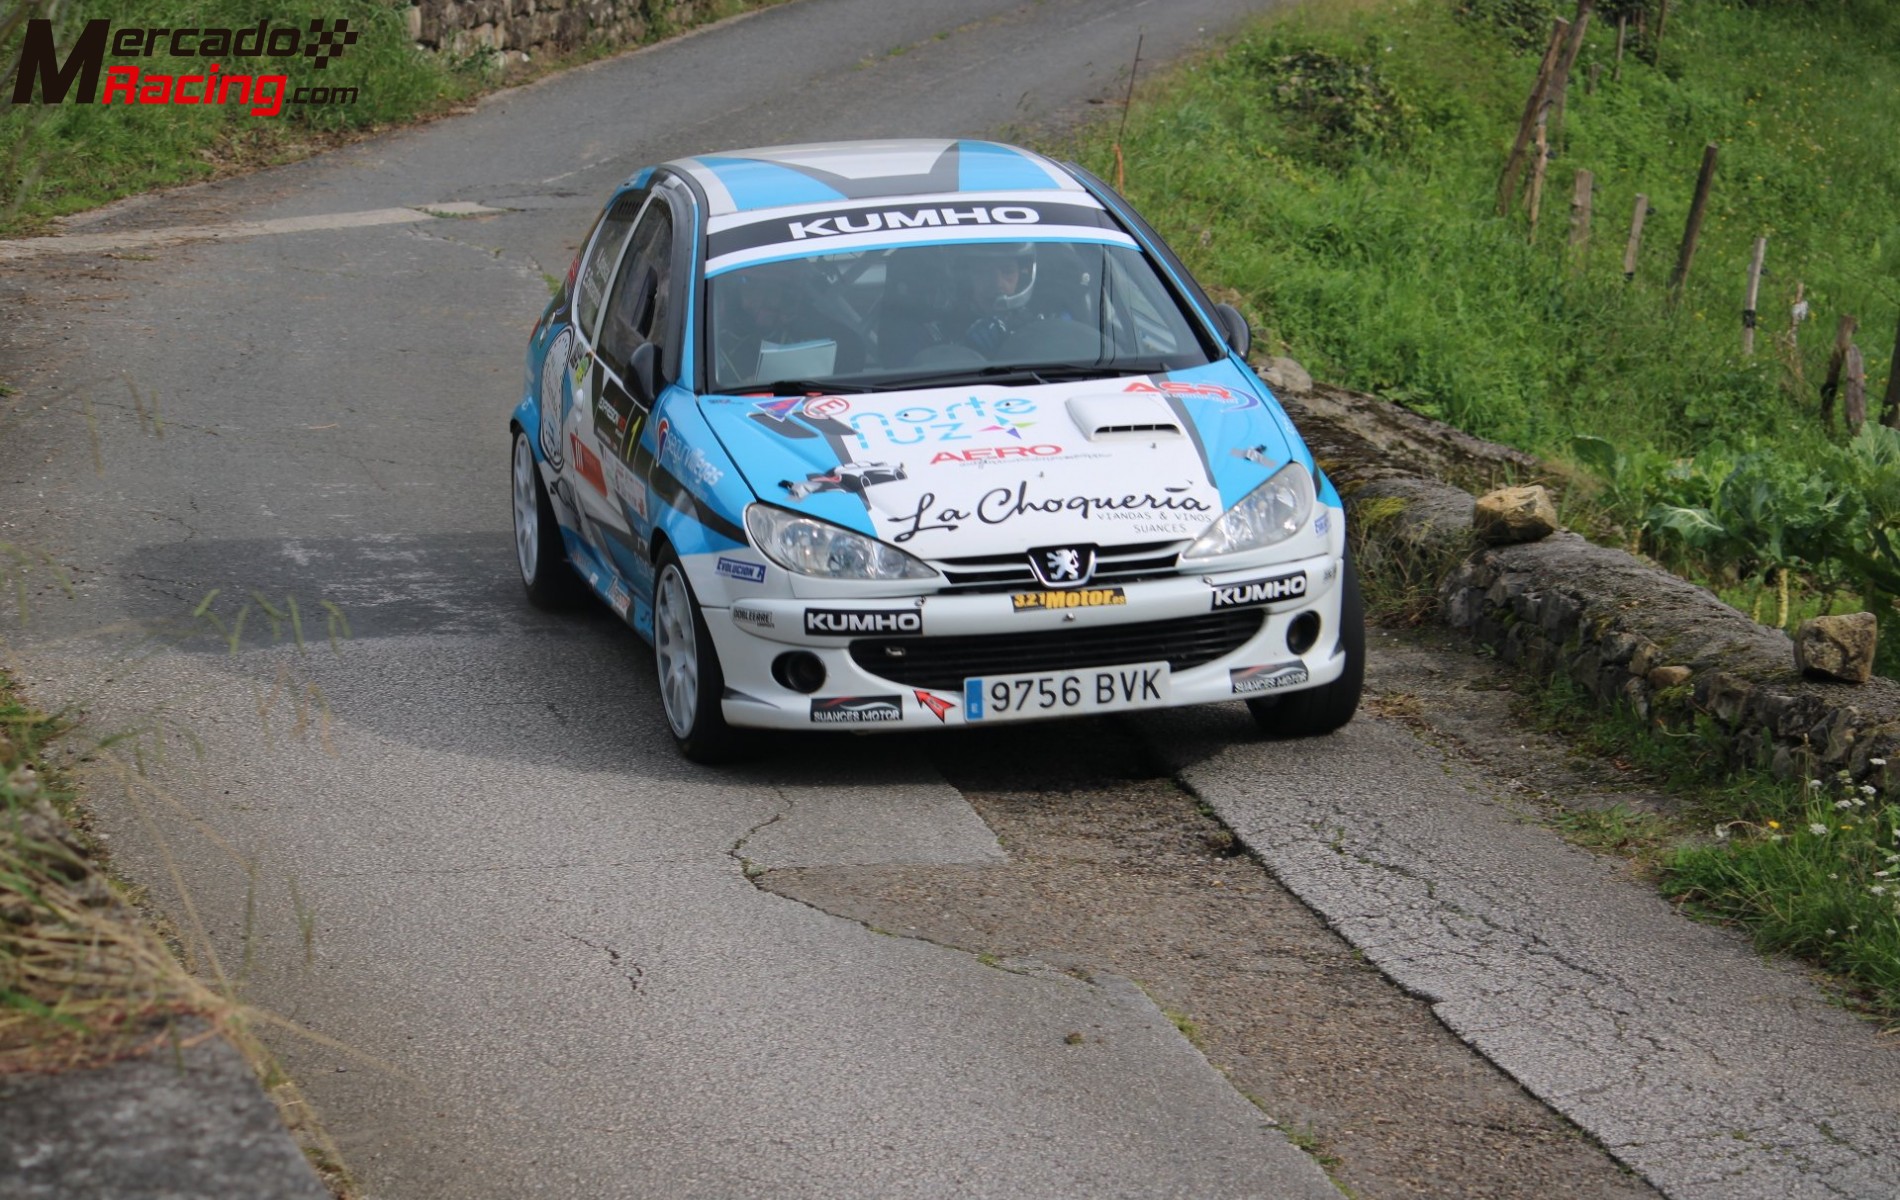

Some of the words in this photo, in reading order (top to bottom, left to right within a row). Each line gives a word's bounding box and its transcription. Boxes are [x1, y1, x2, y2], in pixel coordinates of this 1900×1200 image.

[788, 206, 1040, 240] KUMHO
[1123, 382, 1234, 399] ASR
[626, 415, 642, 462] 1
[930, 444, 1063, 465] AERO
[888, 493, 970, 542] La
[1096, 511, 1152, 521] VIANDAS
[1159, 511, 1168, 520] &
[1174, 511, 1212, 523] VINOS
[1132, 523, 1187, 533] SUANCES
[1214, 575, 1307, 606] KUMHO
[806, 612, 921, 632] KUMHO
[991, 676, 1081, 713] 9756
[1096, 668, 1162, 704] BVK
[813, 711, 860, 722] SUANCES
[862, 709, 900, 721] MOTOR
